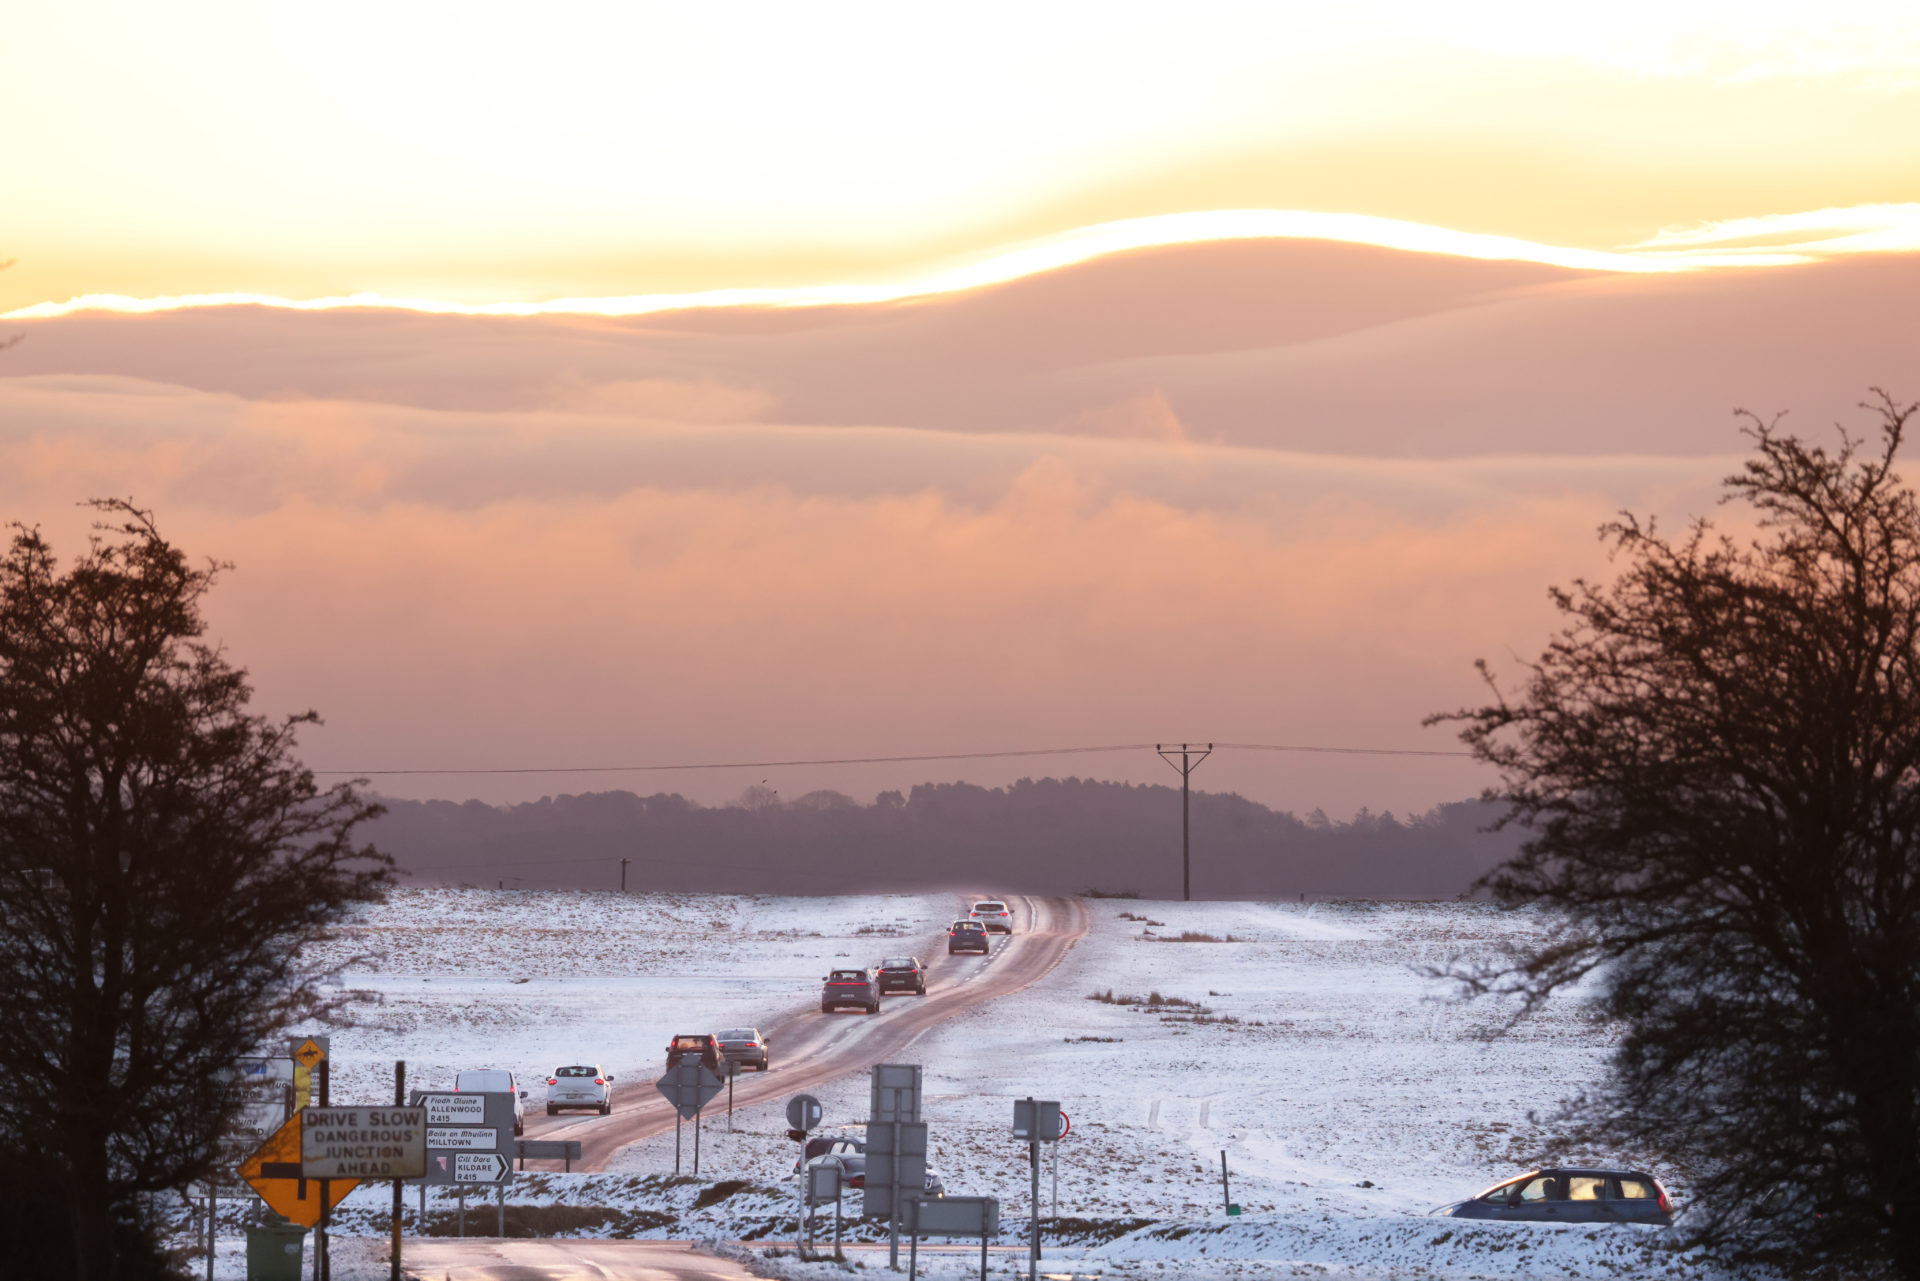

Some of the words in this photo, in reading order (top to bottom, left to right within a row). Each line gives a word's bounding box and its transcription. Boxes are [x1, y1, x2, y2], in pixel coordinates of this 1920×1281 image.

[306, 1112, 358, 1127] DRIVE
[369, 1111, 420, 1127] SLOW
[314, 1130, 413, 1142] DANGEROUS
[326, 1146, 404, 1159] JUNCTION
[457, 1155, 470, 1163] Cill
[472, 1155, 491, 1163] Dara
[336, 1162, 391, 1174] AHEAD
[457, 1164, 492, 1172] KILDARE
